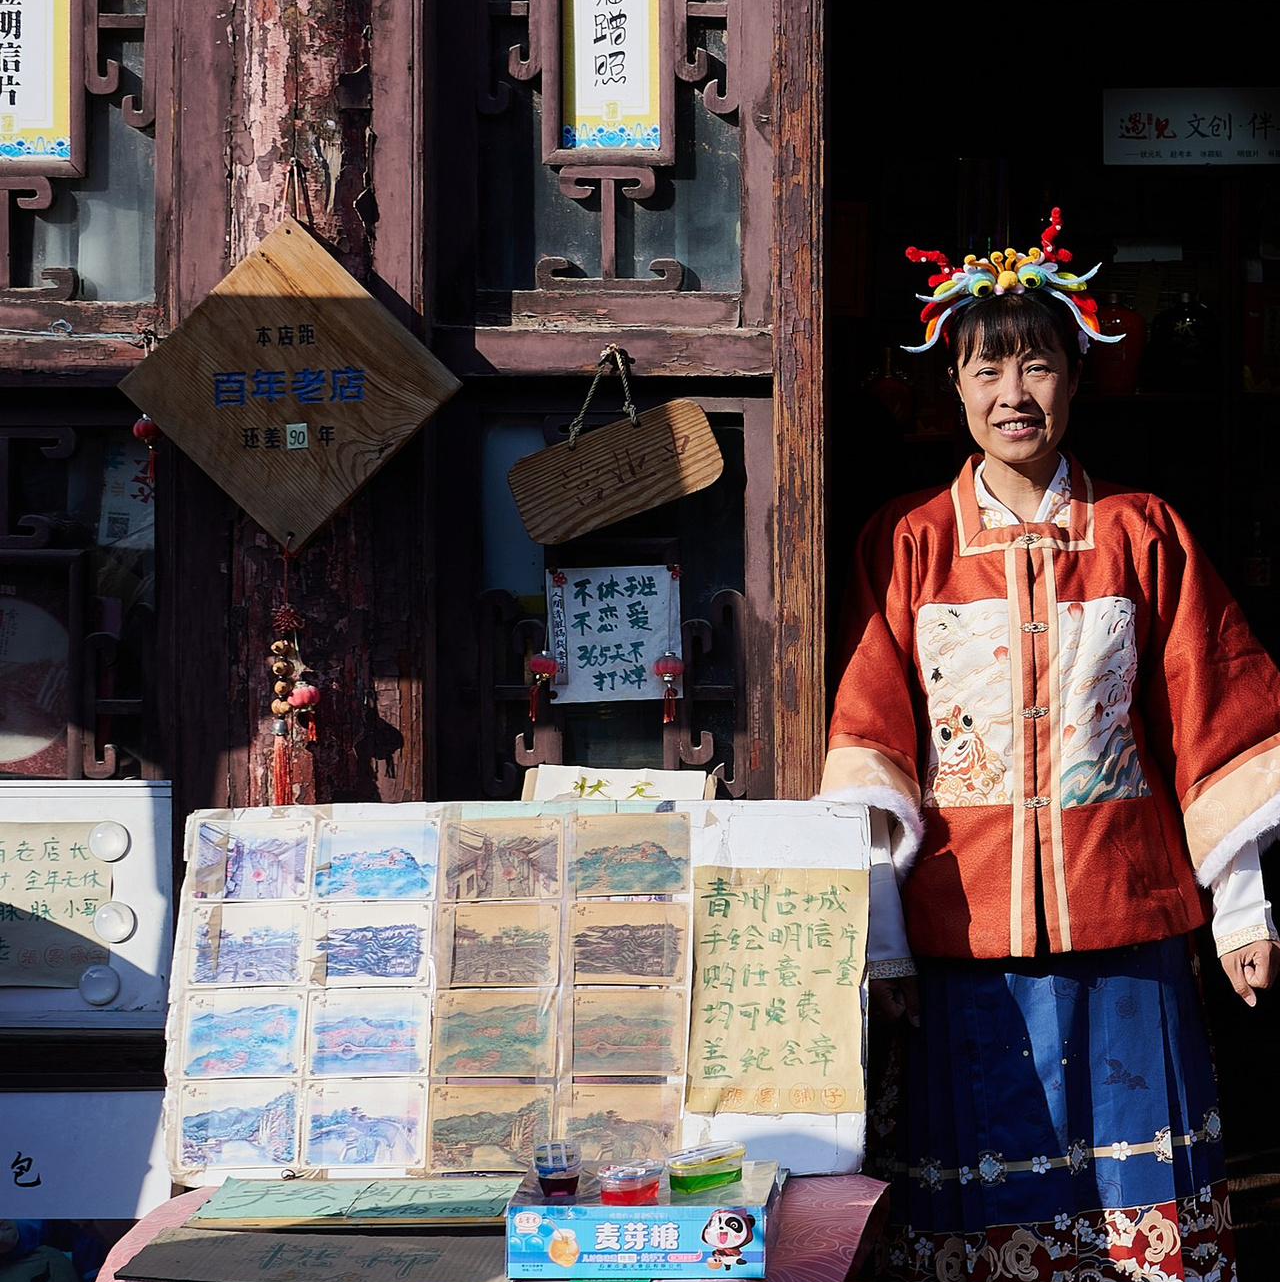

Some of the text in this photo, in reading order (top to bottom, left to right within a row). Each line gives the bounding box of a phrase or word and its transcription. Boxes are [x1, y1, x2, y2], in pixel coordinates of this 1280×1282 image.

[255, 324, 316, 348] 本店距
[212, 366, 366, 407] 百年老店
[572, 574, 659, 607] 不休班
[571, 601, 653, 637] 不恋爱
[577, 641, 645, 669] 365天不
[592, 664, 648, 692] 打烊
[700, 876, 852, 924] 青州古城
[700, 919, 860, 959] 手绘明信片
[702, 954, 859, 994] 购任意一套
[702, 1032, 837, 1081] 盖纪念章
[10, 1151, 42, 1188] 包
[594, 1221, 680, 1251] 麦芽糖
